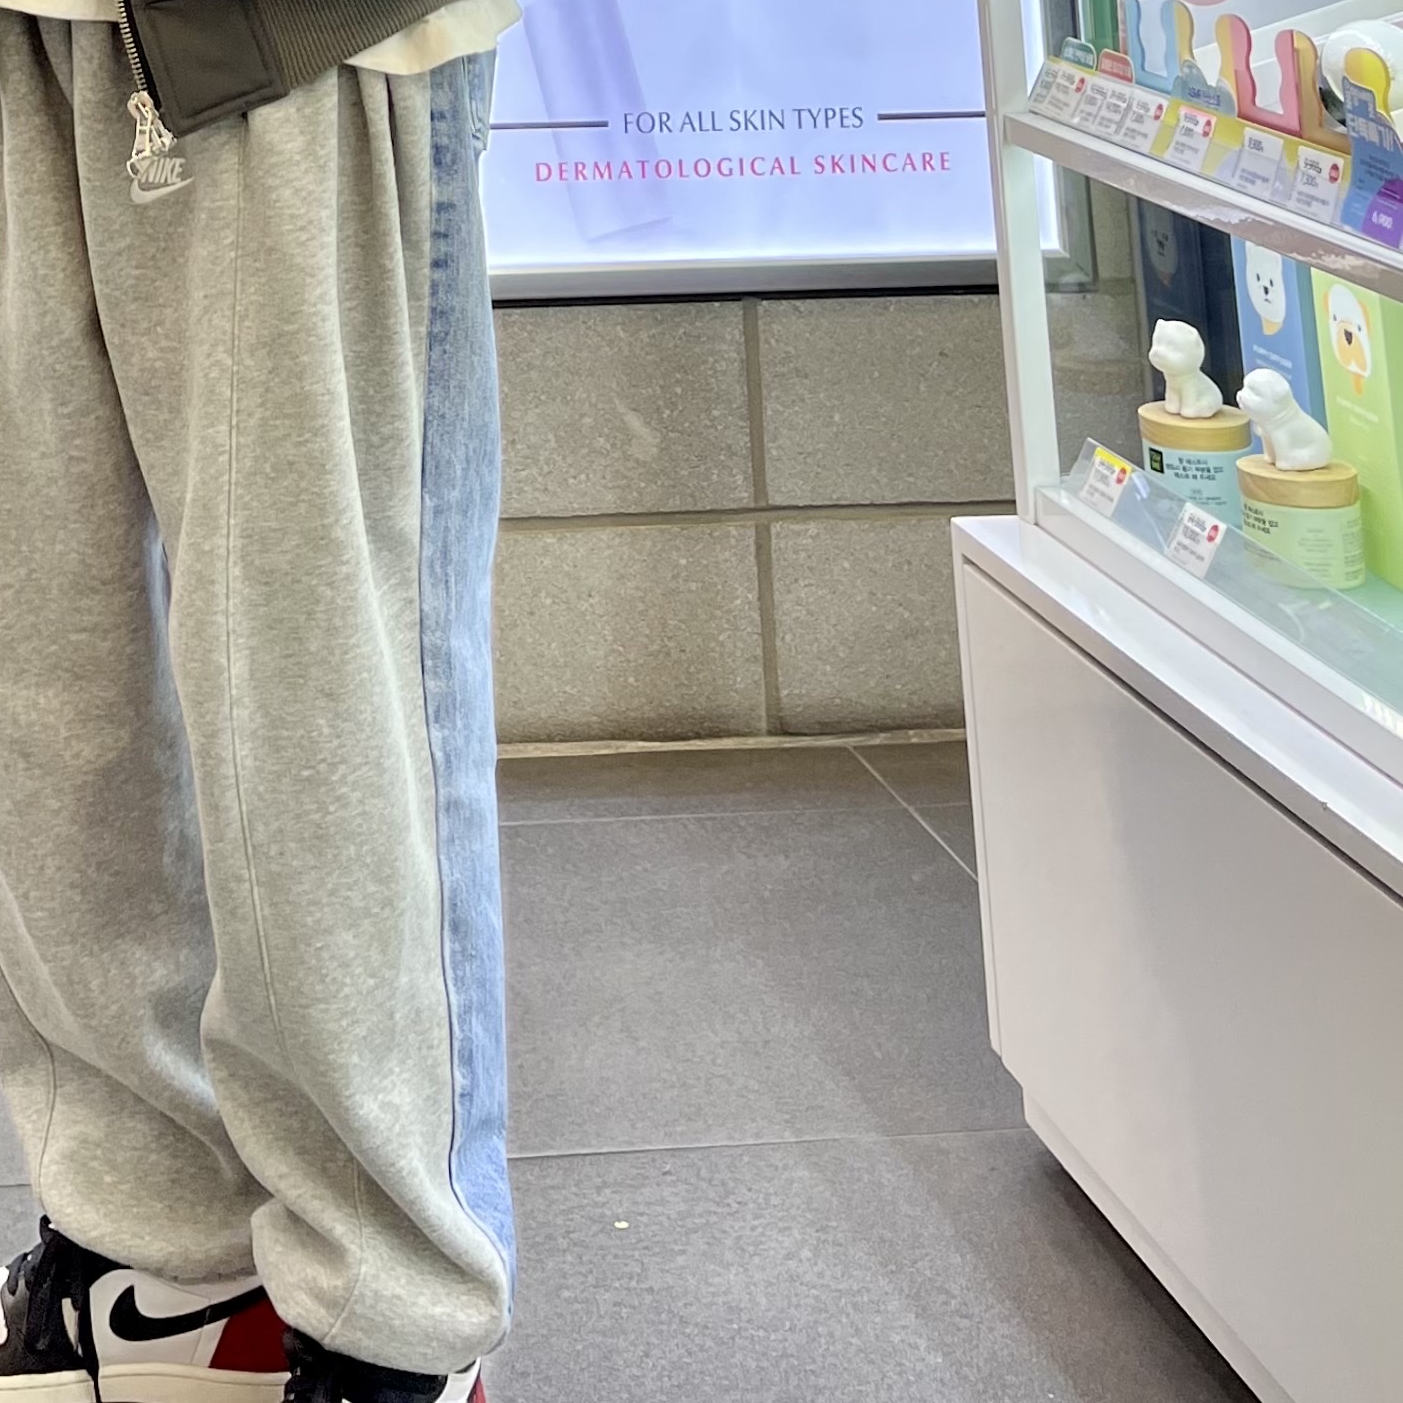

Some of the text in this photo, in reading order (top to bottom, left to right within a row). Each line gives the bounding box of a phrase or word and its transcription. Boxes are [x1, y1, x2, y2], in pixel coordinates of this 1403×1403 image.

[623, 106, 865, 135] FOR ALL SKIN TYPES
[535, 151, 952, 182] DERMATOLOGICAL SKINCARE
